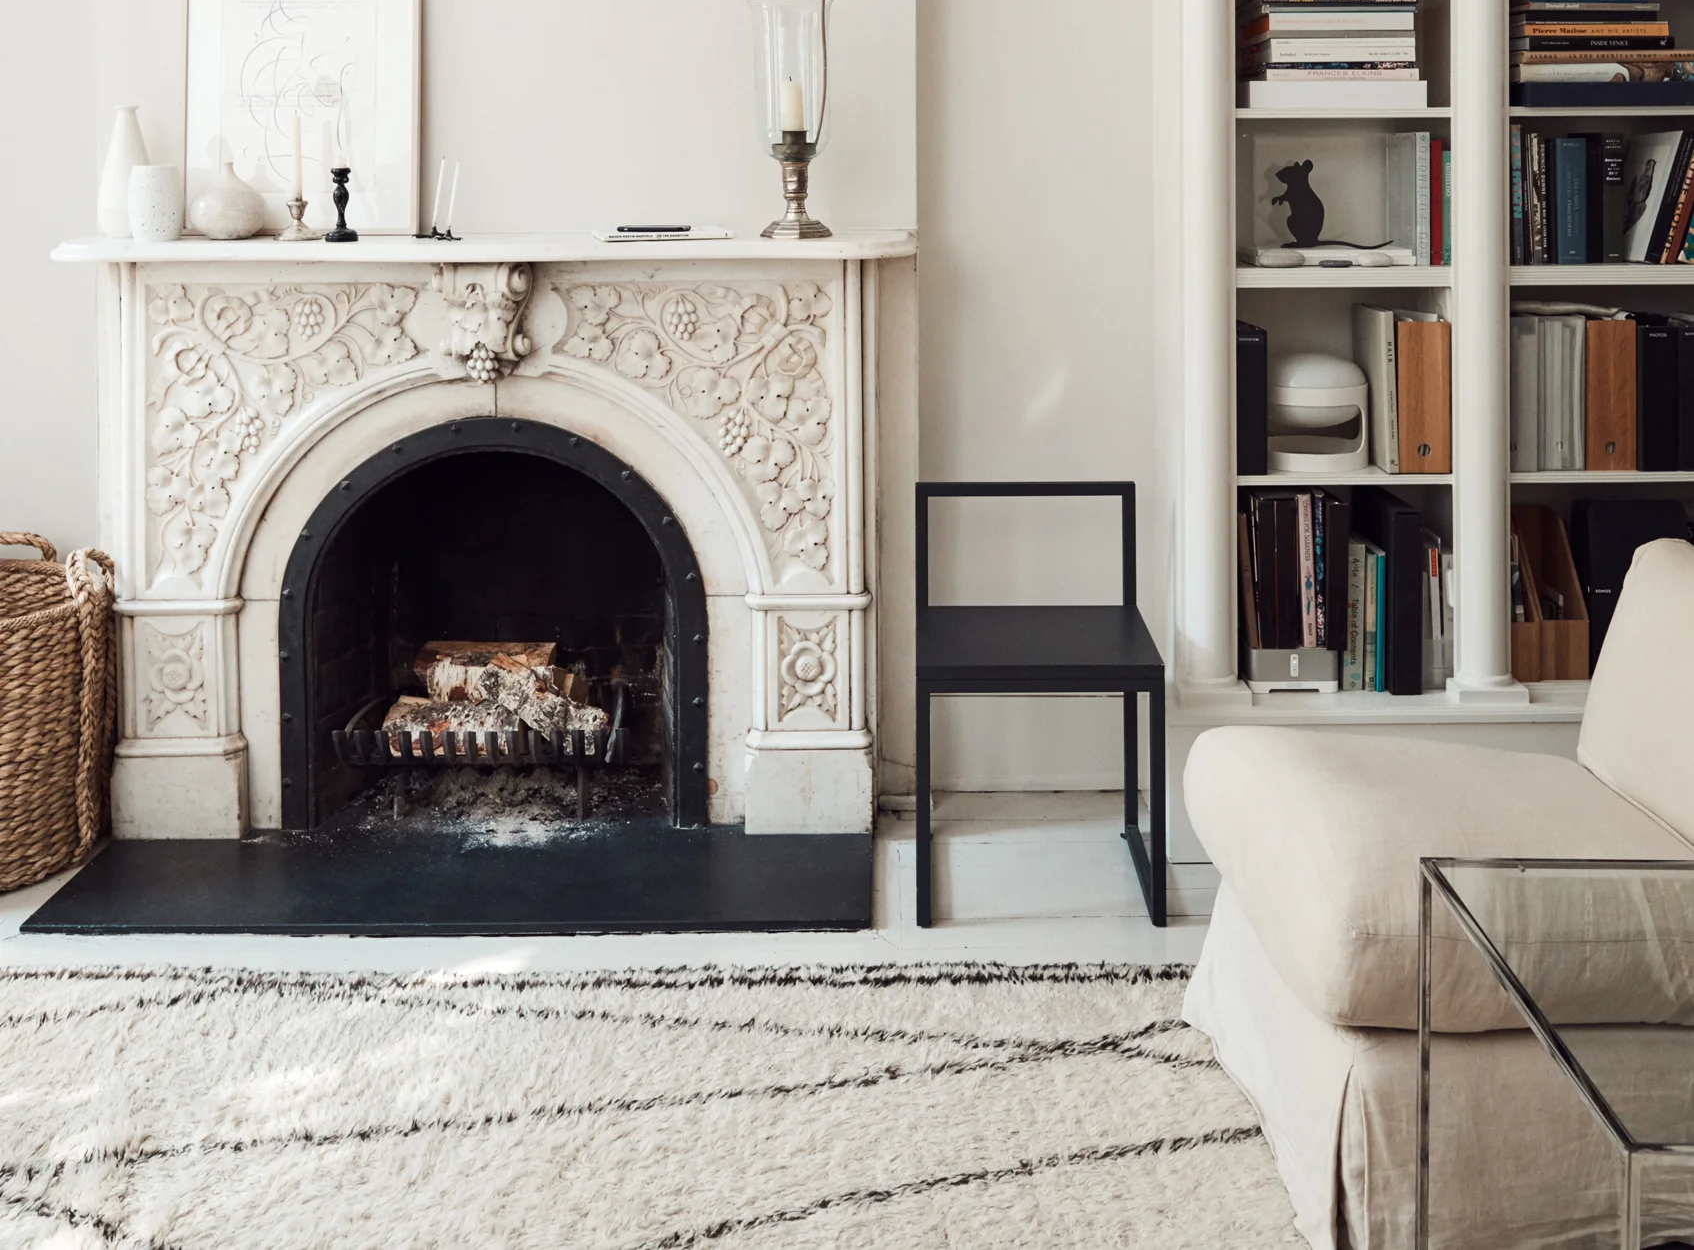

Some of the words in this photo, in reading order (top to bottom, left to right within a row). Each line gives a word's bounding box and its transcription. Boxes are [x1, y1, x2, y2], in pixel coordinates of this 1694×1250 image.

[1419, 146, 1428, 222] FUJIMOTO
[1511, 132, 1523, 219] FASHION
[1420, 233, 1428, 259] SOU
[1352, 558, 1360, 578] Arita
[1351, 598, 1359, 618] Table
[1351, 620, 1359, 629] of
[1350, 630, 1358, 666] Contents
